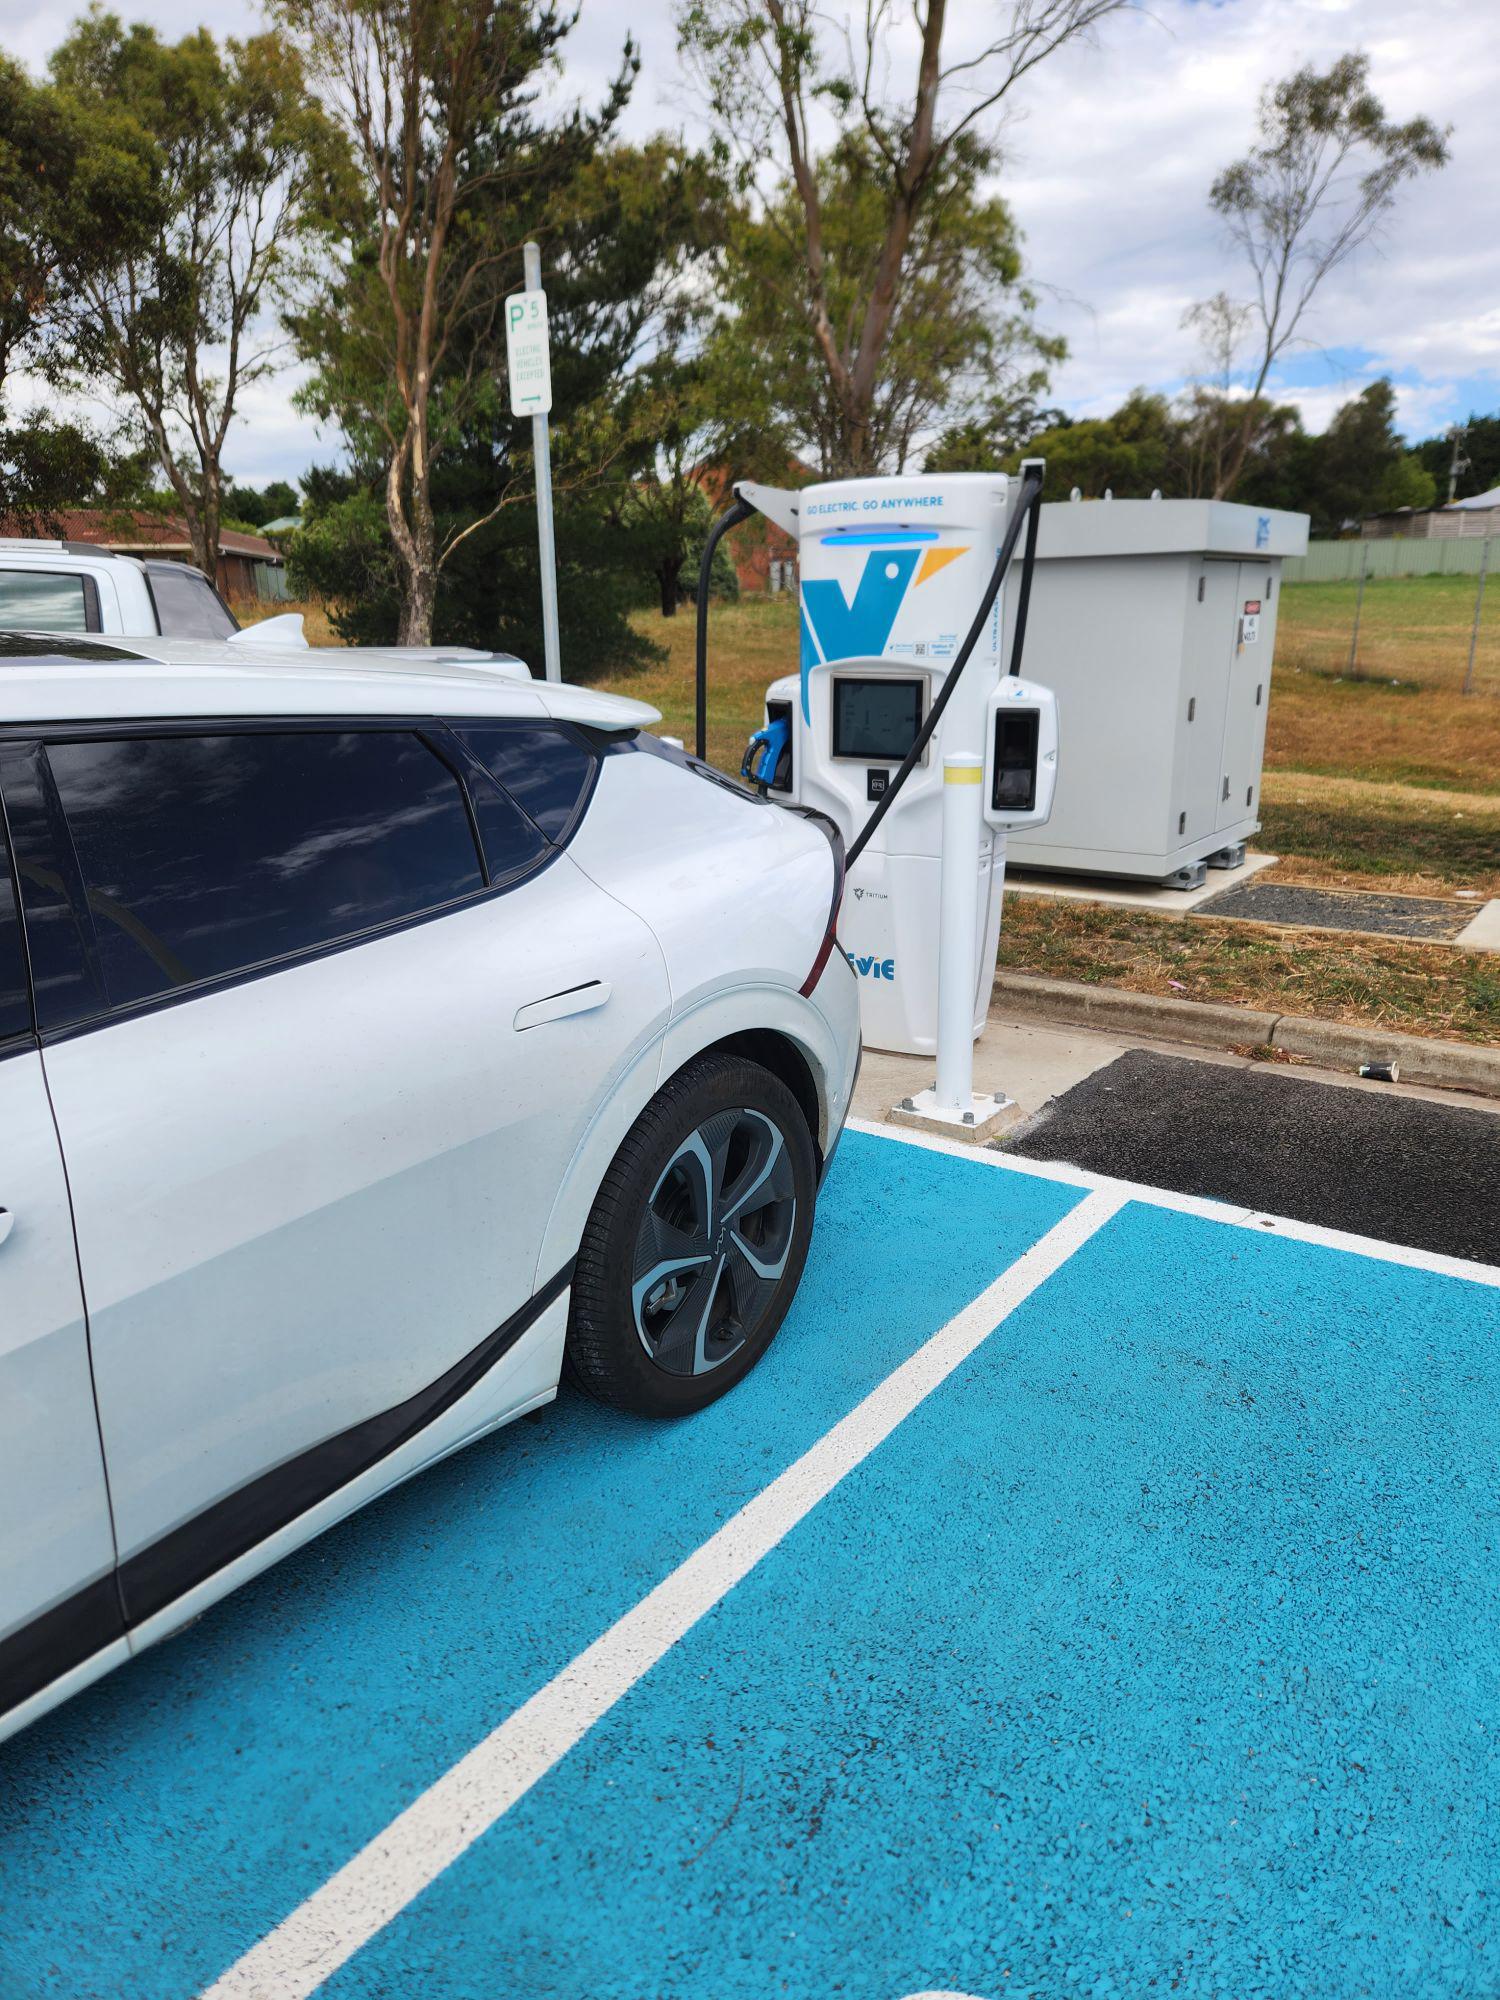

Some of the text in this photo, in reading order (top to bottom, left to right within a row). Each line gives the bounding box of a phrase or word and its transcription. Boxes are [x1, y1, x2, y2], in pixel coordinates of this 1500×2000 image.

[510, 305, 524, 333] P
[863, 500, 878, 510] GO
[881, 496, 943, 509] ANYWHERE
